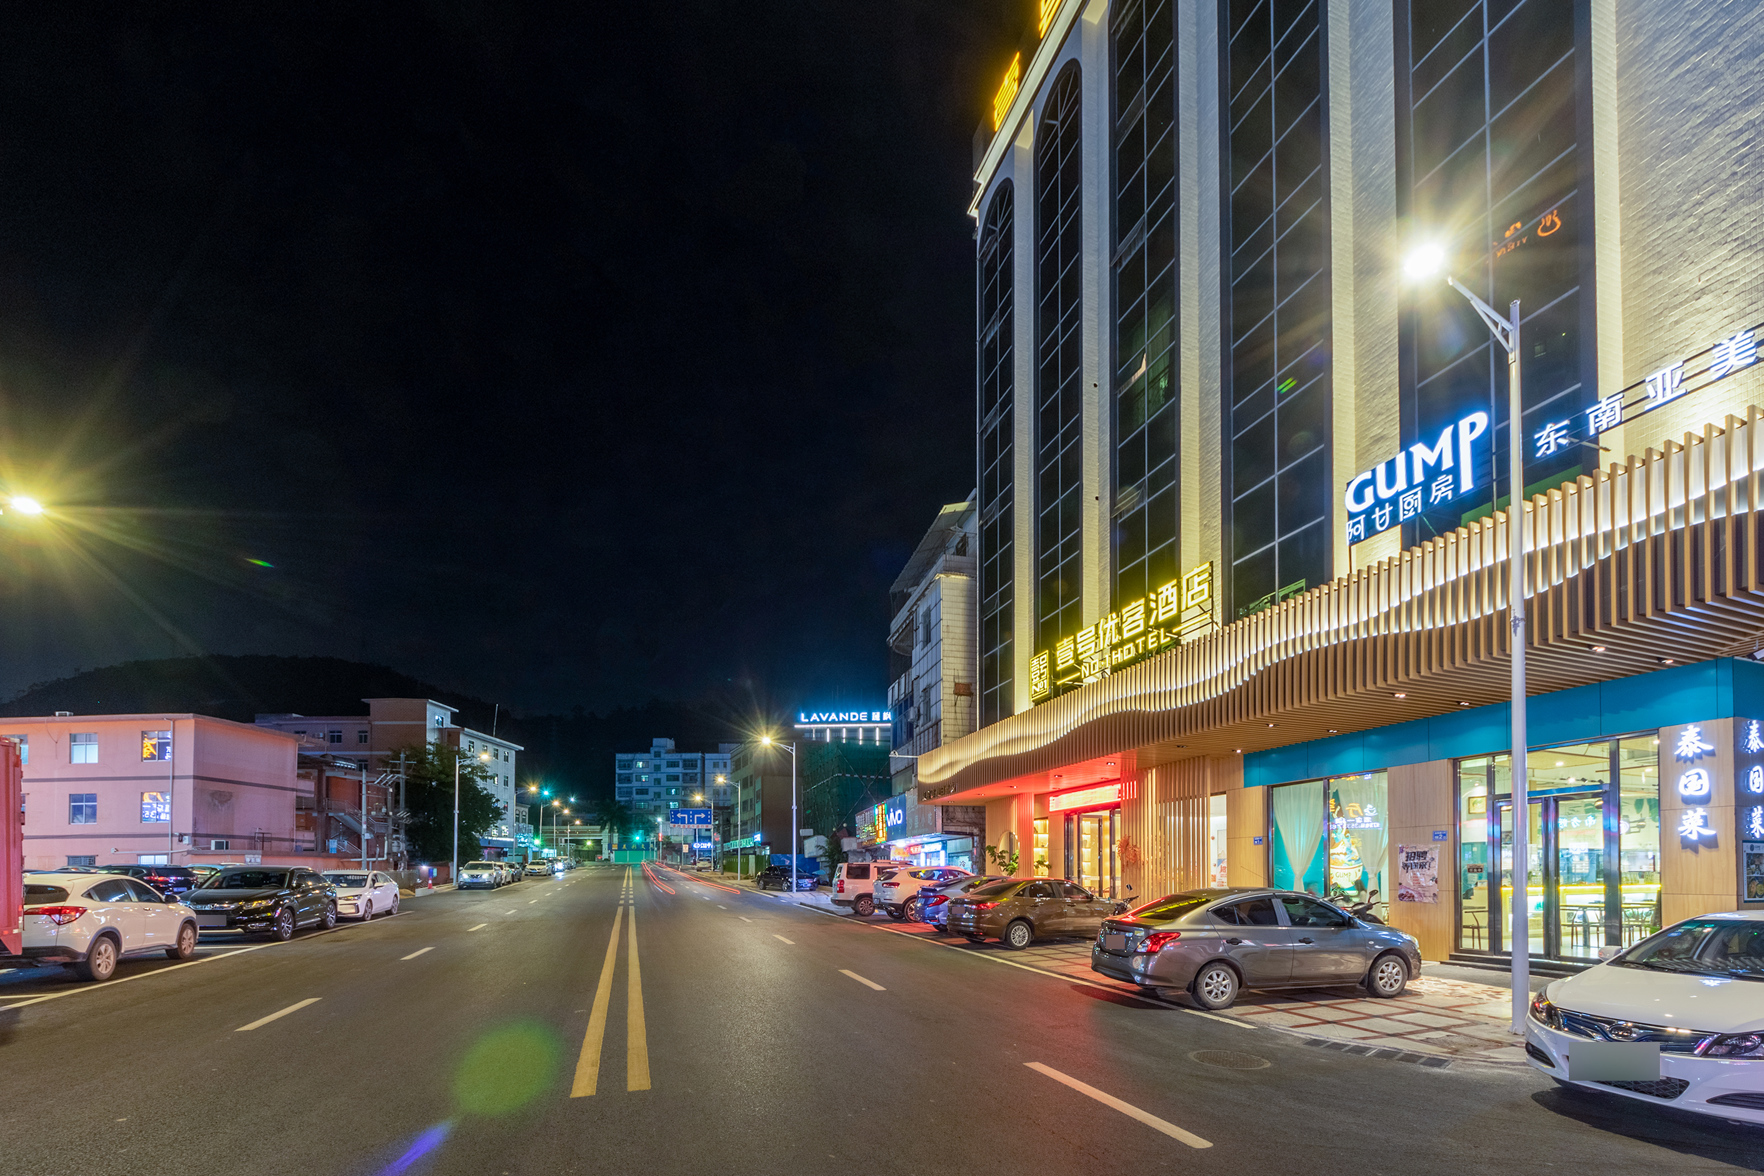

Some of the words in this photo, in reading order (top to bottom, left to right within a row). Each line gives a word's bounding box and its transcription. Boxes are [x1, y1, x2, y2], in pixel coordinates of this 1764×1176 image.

[1533, 330, 1758, 458] 东南亚美
[1344, 410, 1489, 514] GUMP
[1346, 474, 1455, 546] 阿甘厨房
[1056, 561, 1211, 671] 壹号优客酒店
[800, 712, 868, 722] LAVANDE
[1674, 724, 1717, 840] 泰国菜
